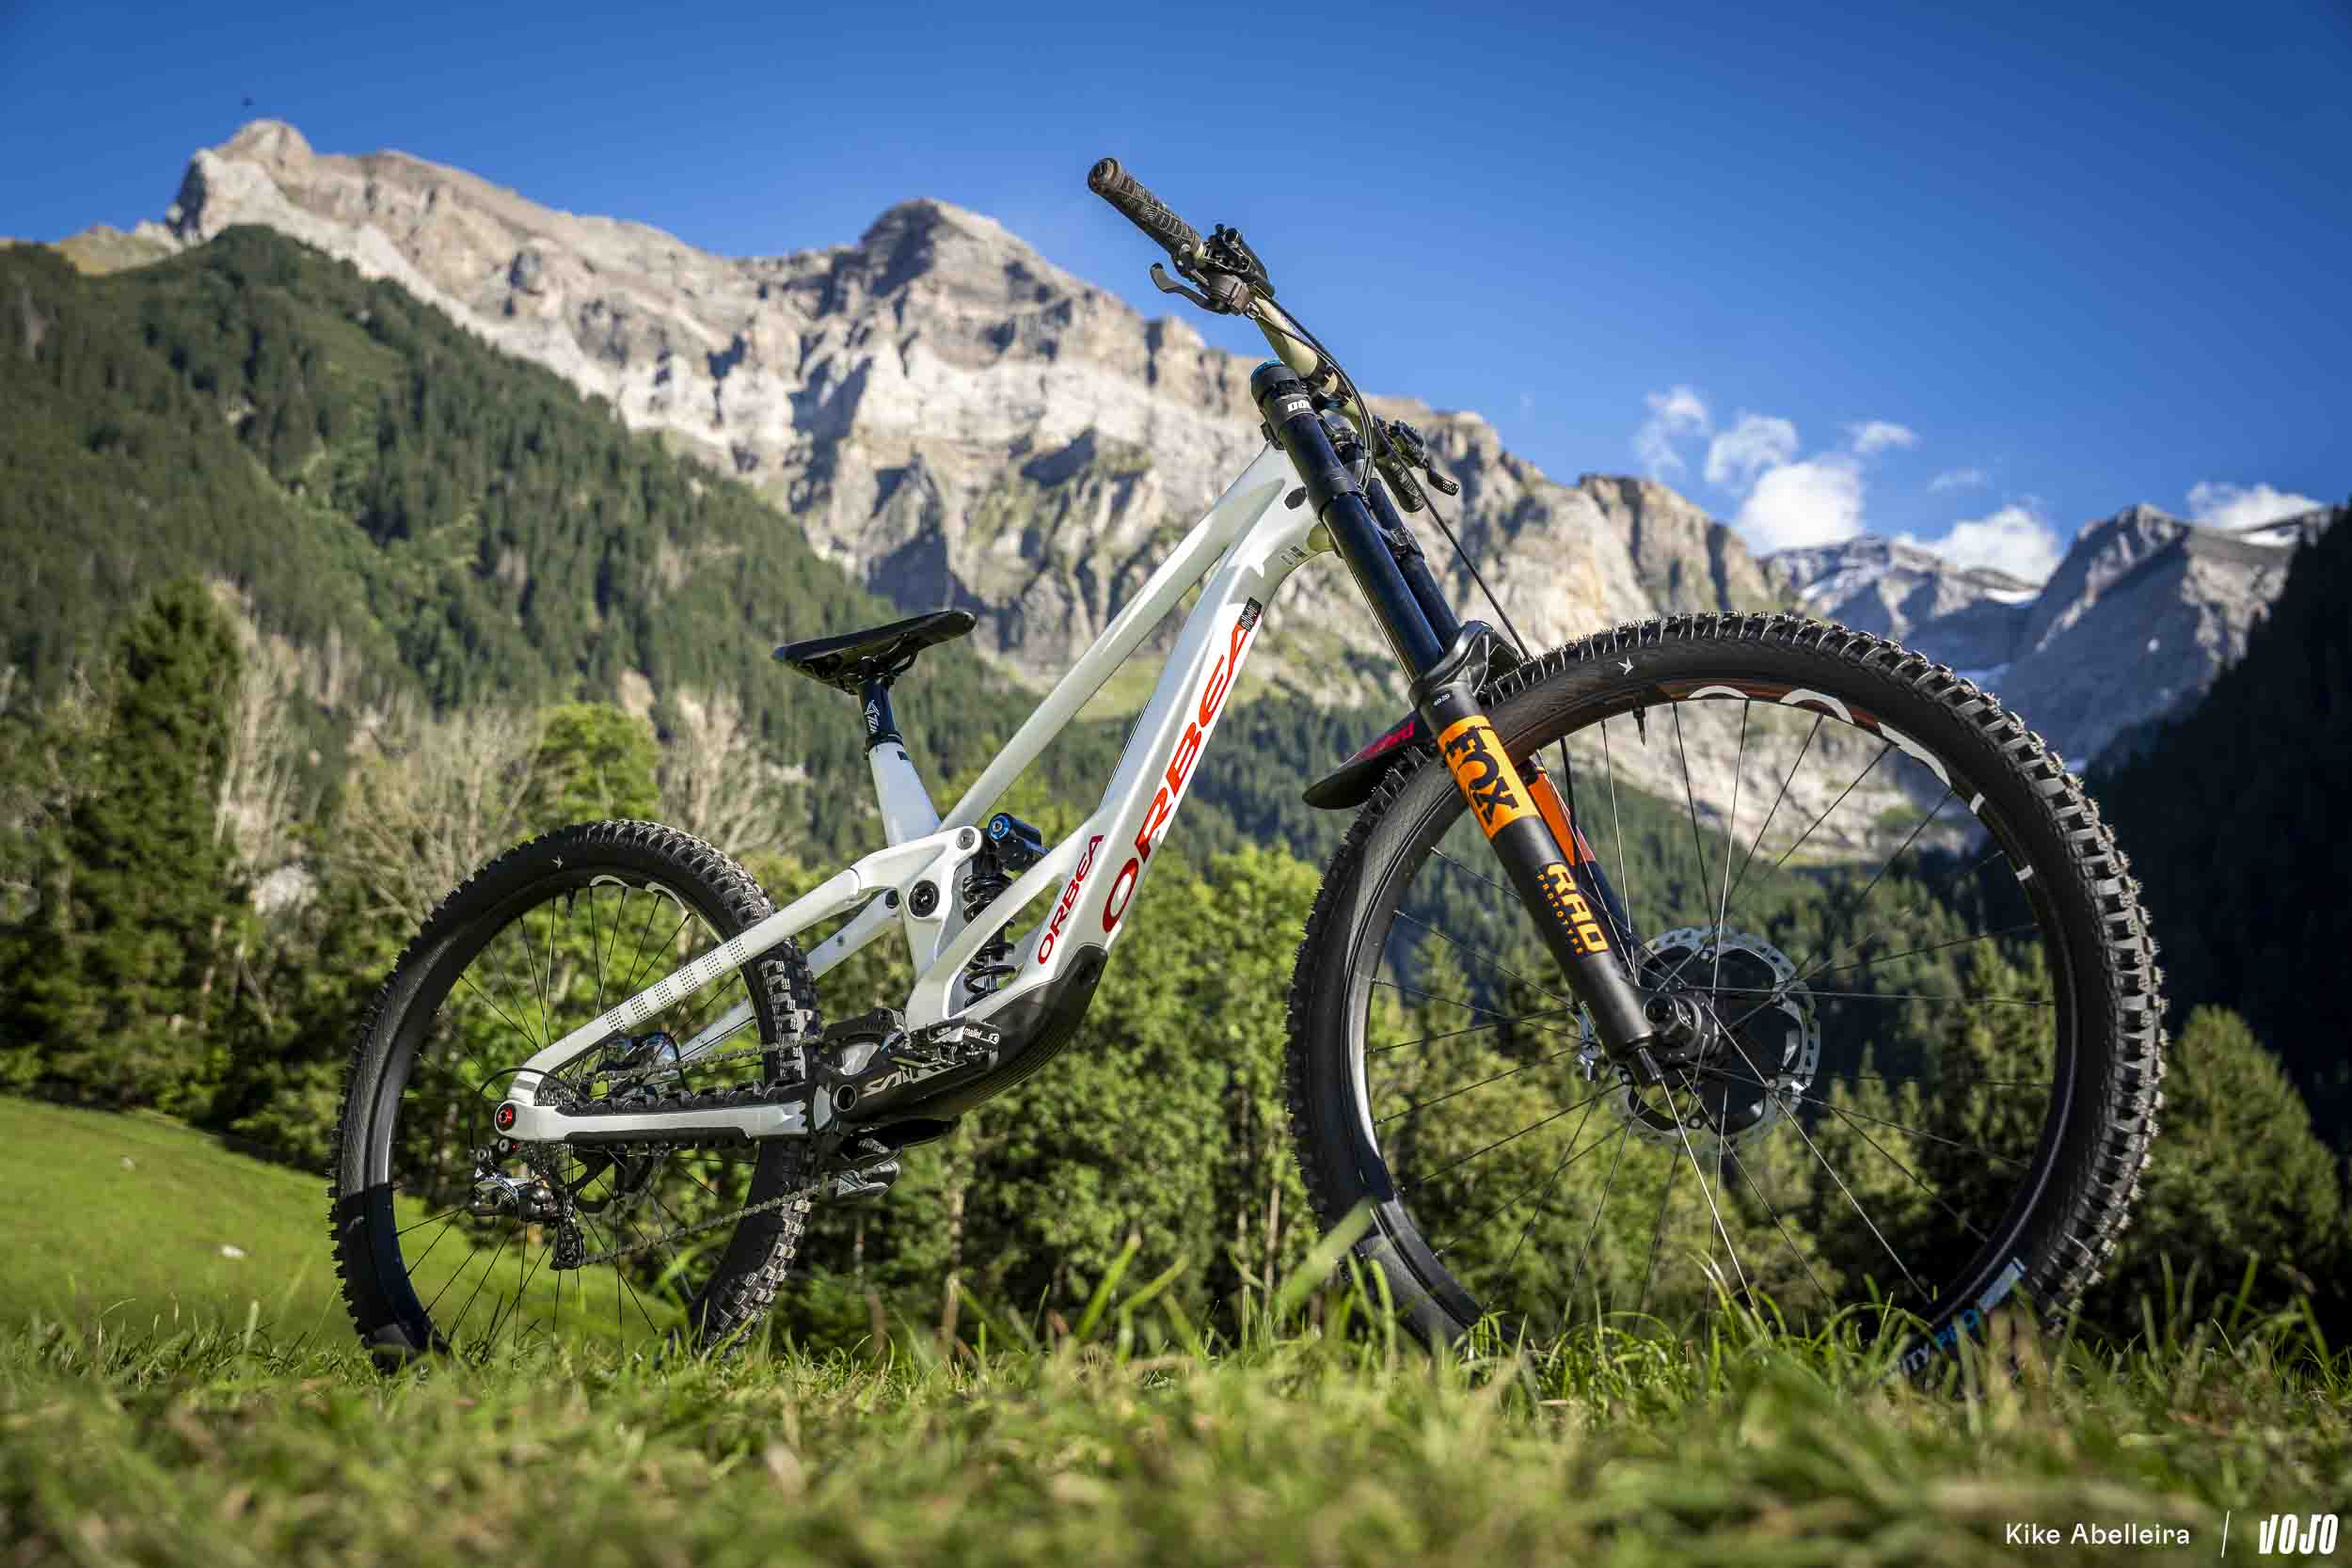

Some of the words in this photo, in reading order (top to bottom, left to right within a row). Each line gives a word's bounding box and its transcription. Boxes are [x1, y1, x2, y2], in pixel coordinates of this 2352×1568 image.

[1103, 623, 1250, 933] ORBEA
[1445, 724, 1519, 827] FOX
[1038, 835, 1104, 964] ORBEA
